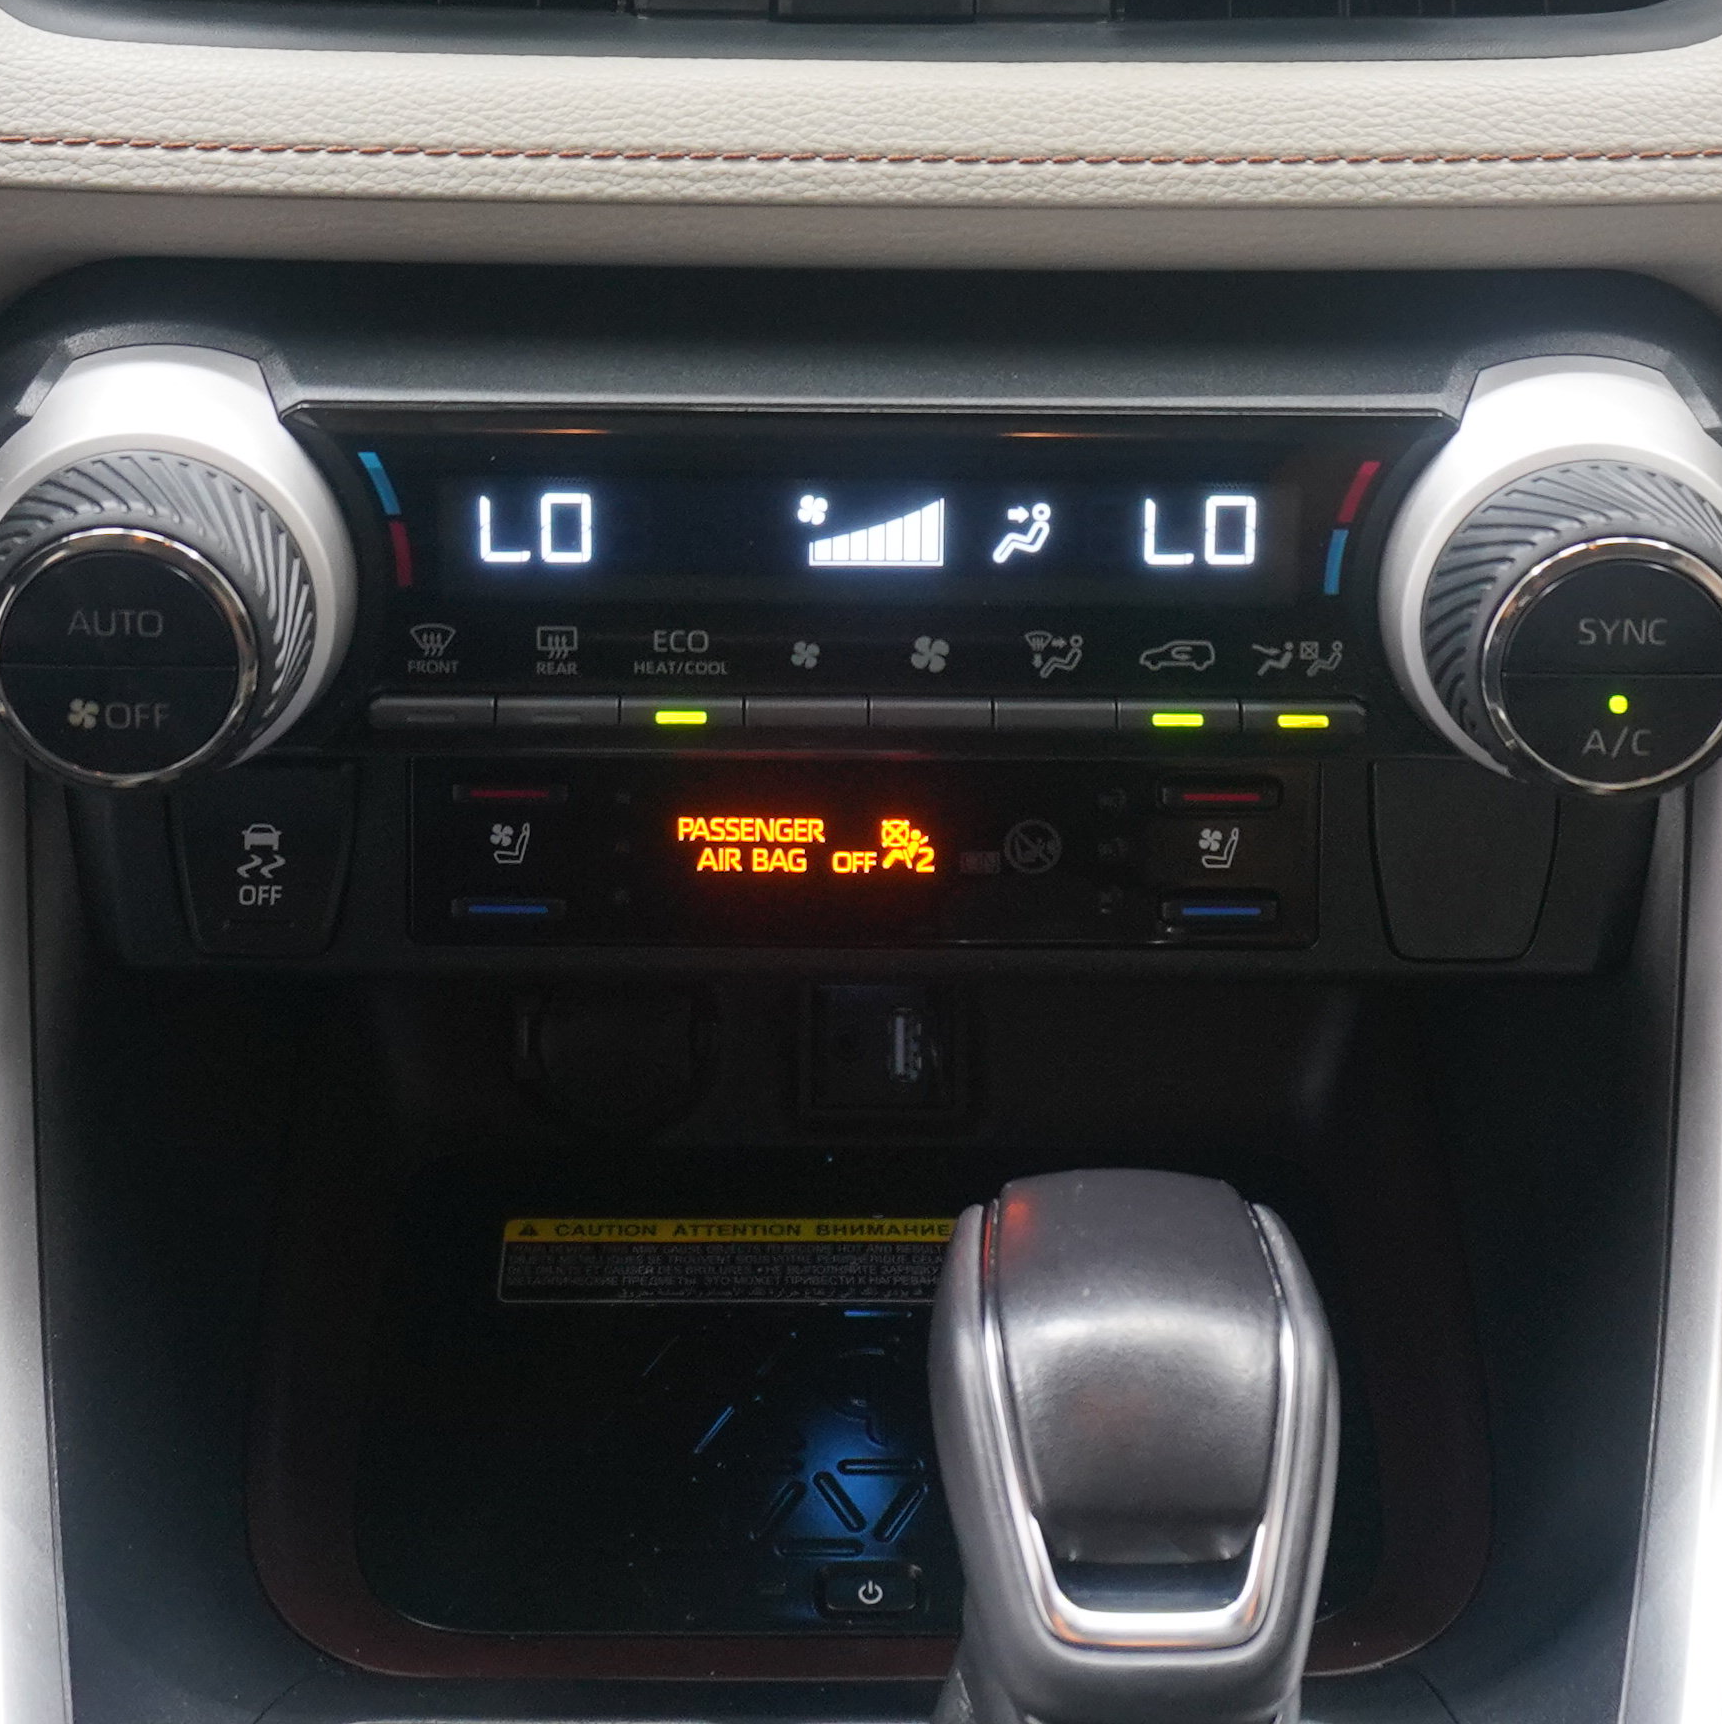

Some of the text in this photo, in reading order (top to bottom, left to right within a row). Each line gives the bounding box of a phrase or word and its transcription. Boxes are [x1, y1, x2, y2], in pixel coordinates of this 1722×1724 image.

[478, 494, 593, 563] LO
[1143, 495, 1257, 566] LO
[67, 610, 164, 637] AUTO
[1578, 619, 1668, 646] SYNC
[653, 630, 710, 653] ECO
[407, 660, 458, 675] FRONT
[536, 660, 579, 676] REAR
[633, 661, 728, 676] HEAT/COOL
[104, 704, 170, 731] OFF
[1582, 730, 1652, 758] A/C
[677, 817, 826, 844] PASSENGER
[696, 847, 877, 874] AIR BAG OFF
[238, 886, 282, 906] OFF
[554, 1223, 802, 1238] CAUTION ATTENTION
[815, 1222, 950, 1238] ВНИМАНИЕ
